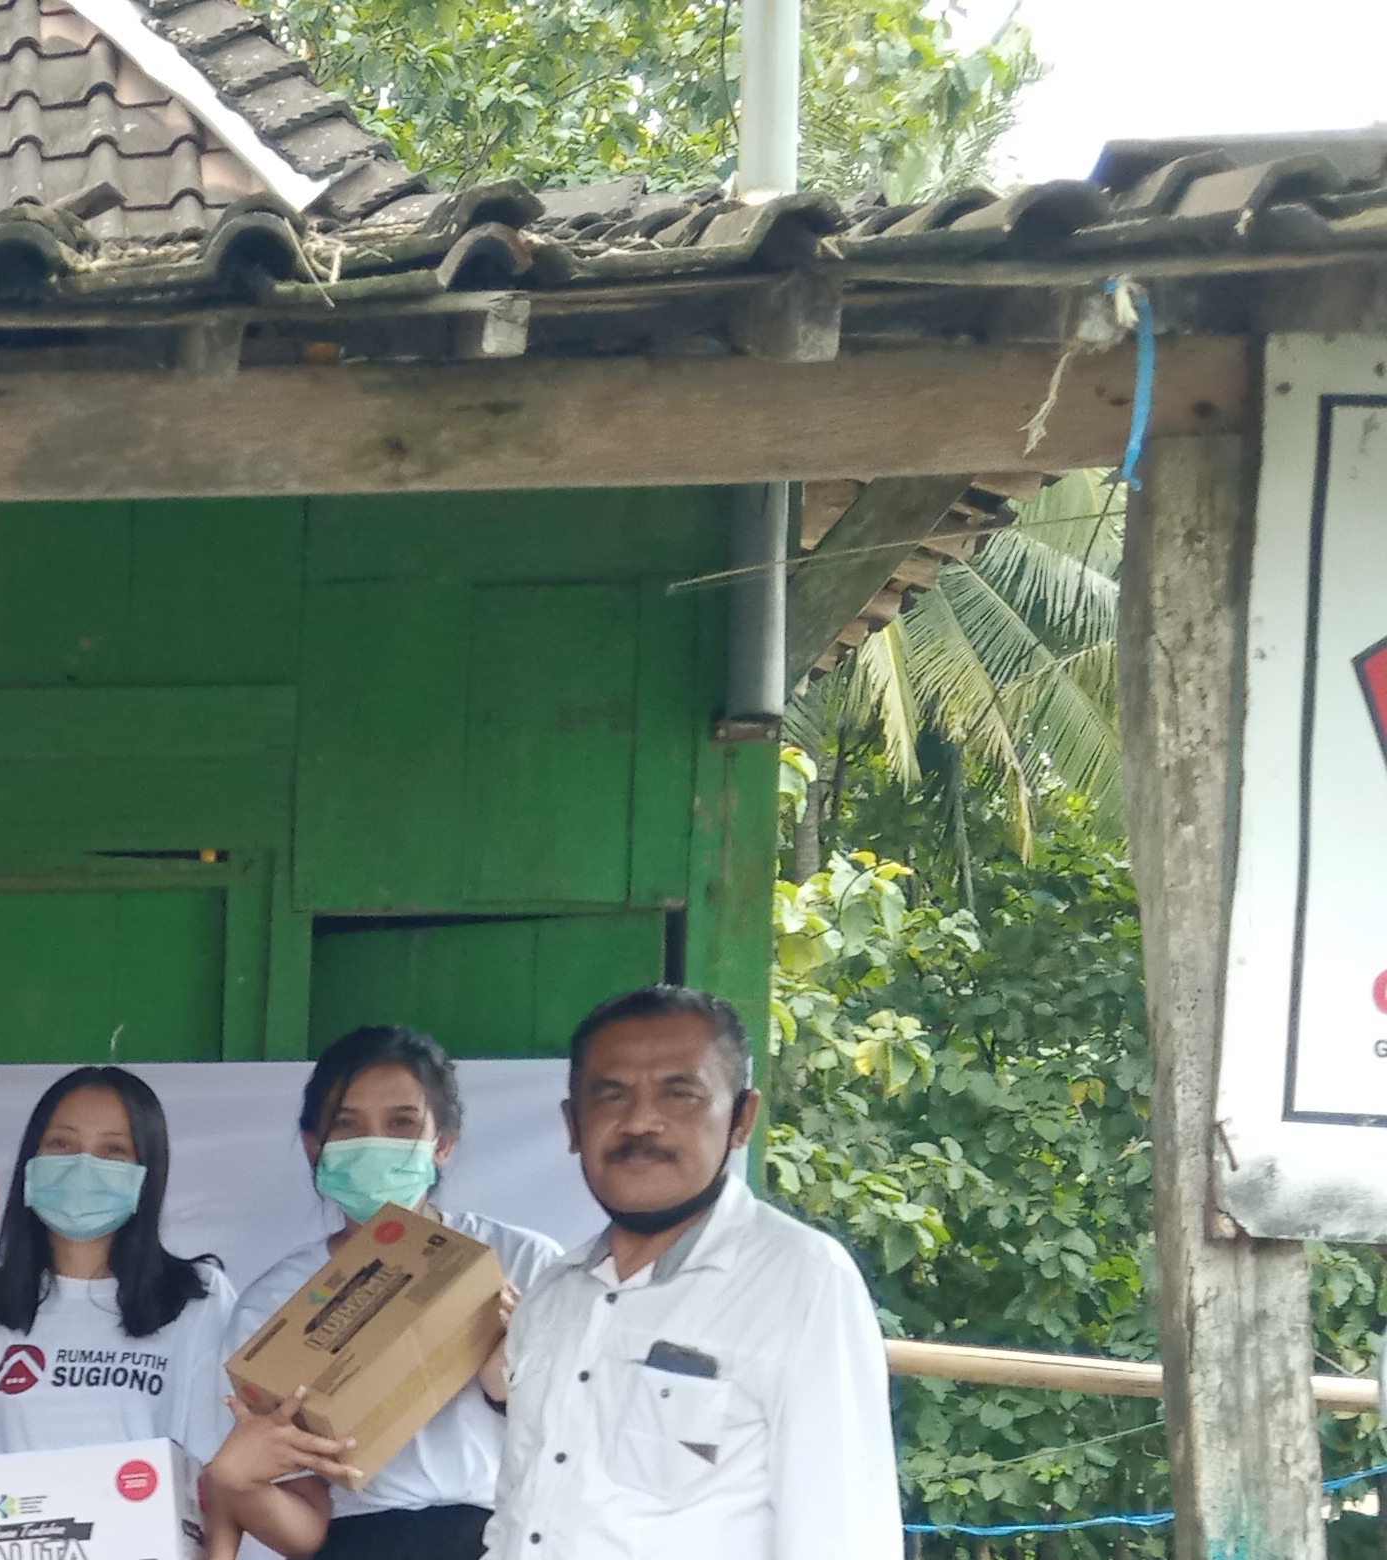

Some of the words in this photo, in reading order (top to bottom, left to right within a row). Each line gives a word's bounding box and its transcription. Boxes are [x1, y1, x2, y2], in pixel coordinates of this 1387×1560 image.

[56, 1349, 117, 1363] RUMAH
[120, 1352, 168, 1372] PUTIH
[52, 1366, 163, 1396] SUGIONO
